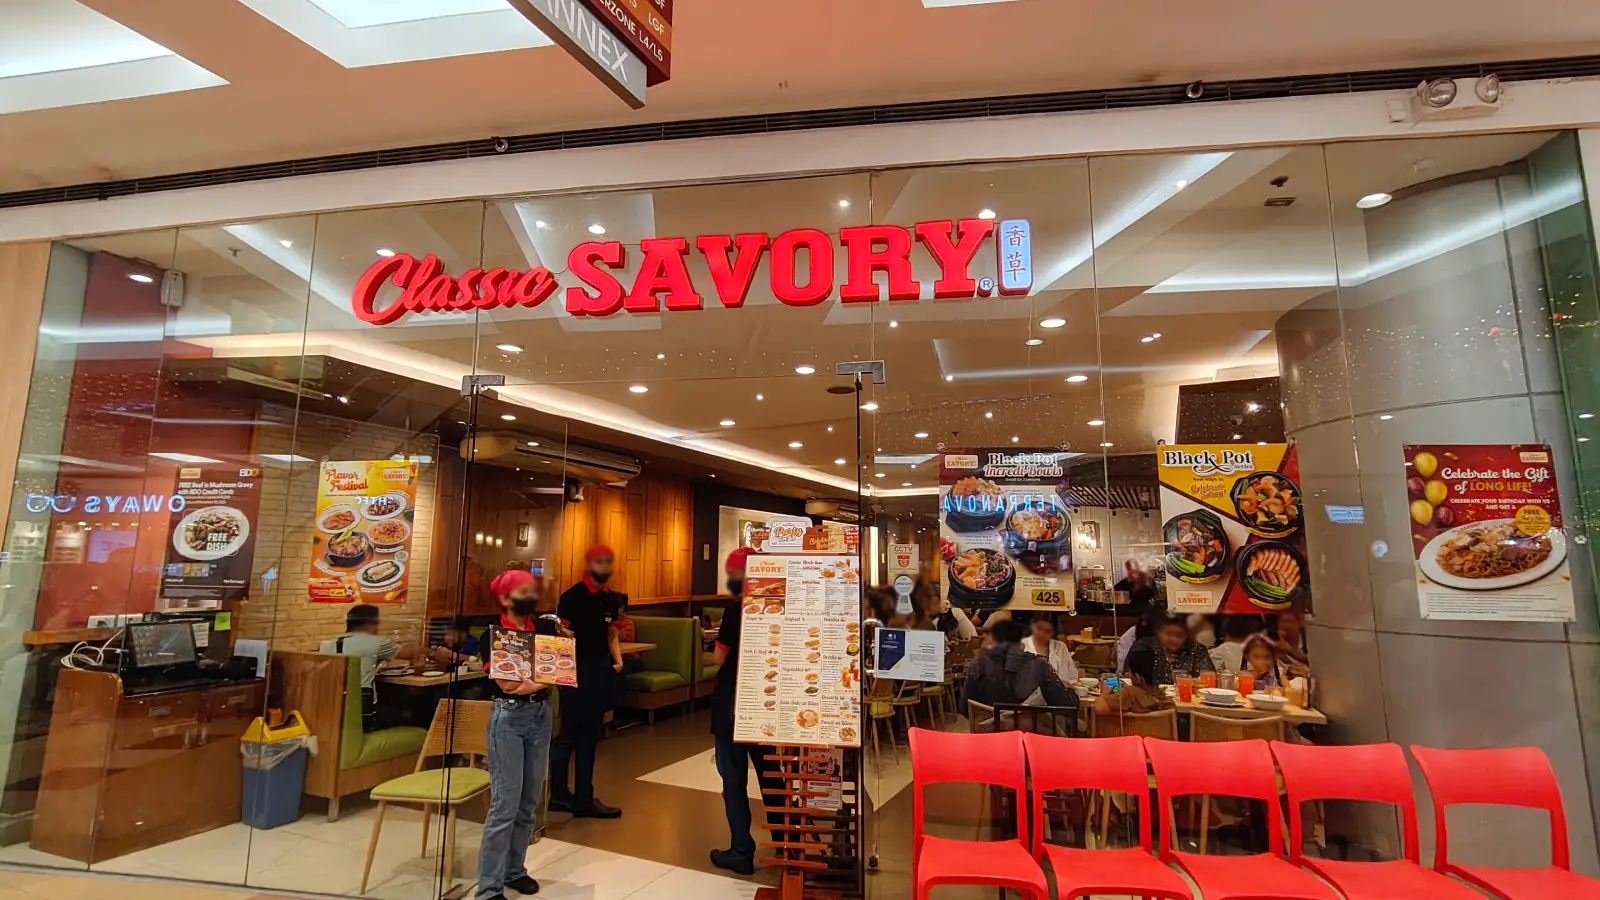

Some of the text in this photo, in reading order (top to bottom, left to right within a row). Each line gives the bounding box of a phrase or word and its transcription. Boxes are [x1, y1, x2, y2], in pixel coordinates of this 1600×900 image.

[648, 11, 665, 36] LGF
[639, 30, 664, 62] L4/L5
[1003, 224, 1028, 282] 香草
[351, 253, 559, 326] Classic
[565, 217, 994, 317] SAVORY
[988, 453, 1058, 466] Black Pot
[1164, 450, 1252, 468] Black Pot
[239, 468, 259, 477] BDO
[326, 468, 359, 481] Flavor
[983, 465, 1063, 477] Incredi-Bowls
[1441, 467, 1550, 482] Celebrate the Gift
[329, 478, 369, 492] Festival
[1454, 481, 1532, 494] of LONG LIFE!
[207, 532, 228, 542] FREE
[774, 526, 804, 537] Party
[206, 542, 228, 551] DISH
[1035, 591, 1061, 603] 425
